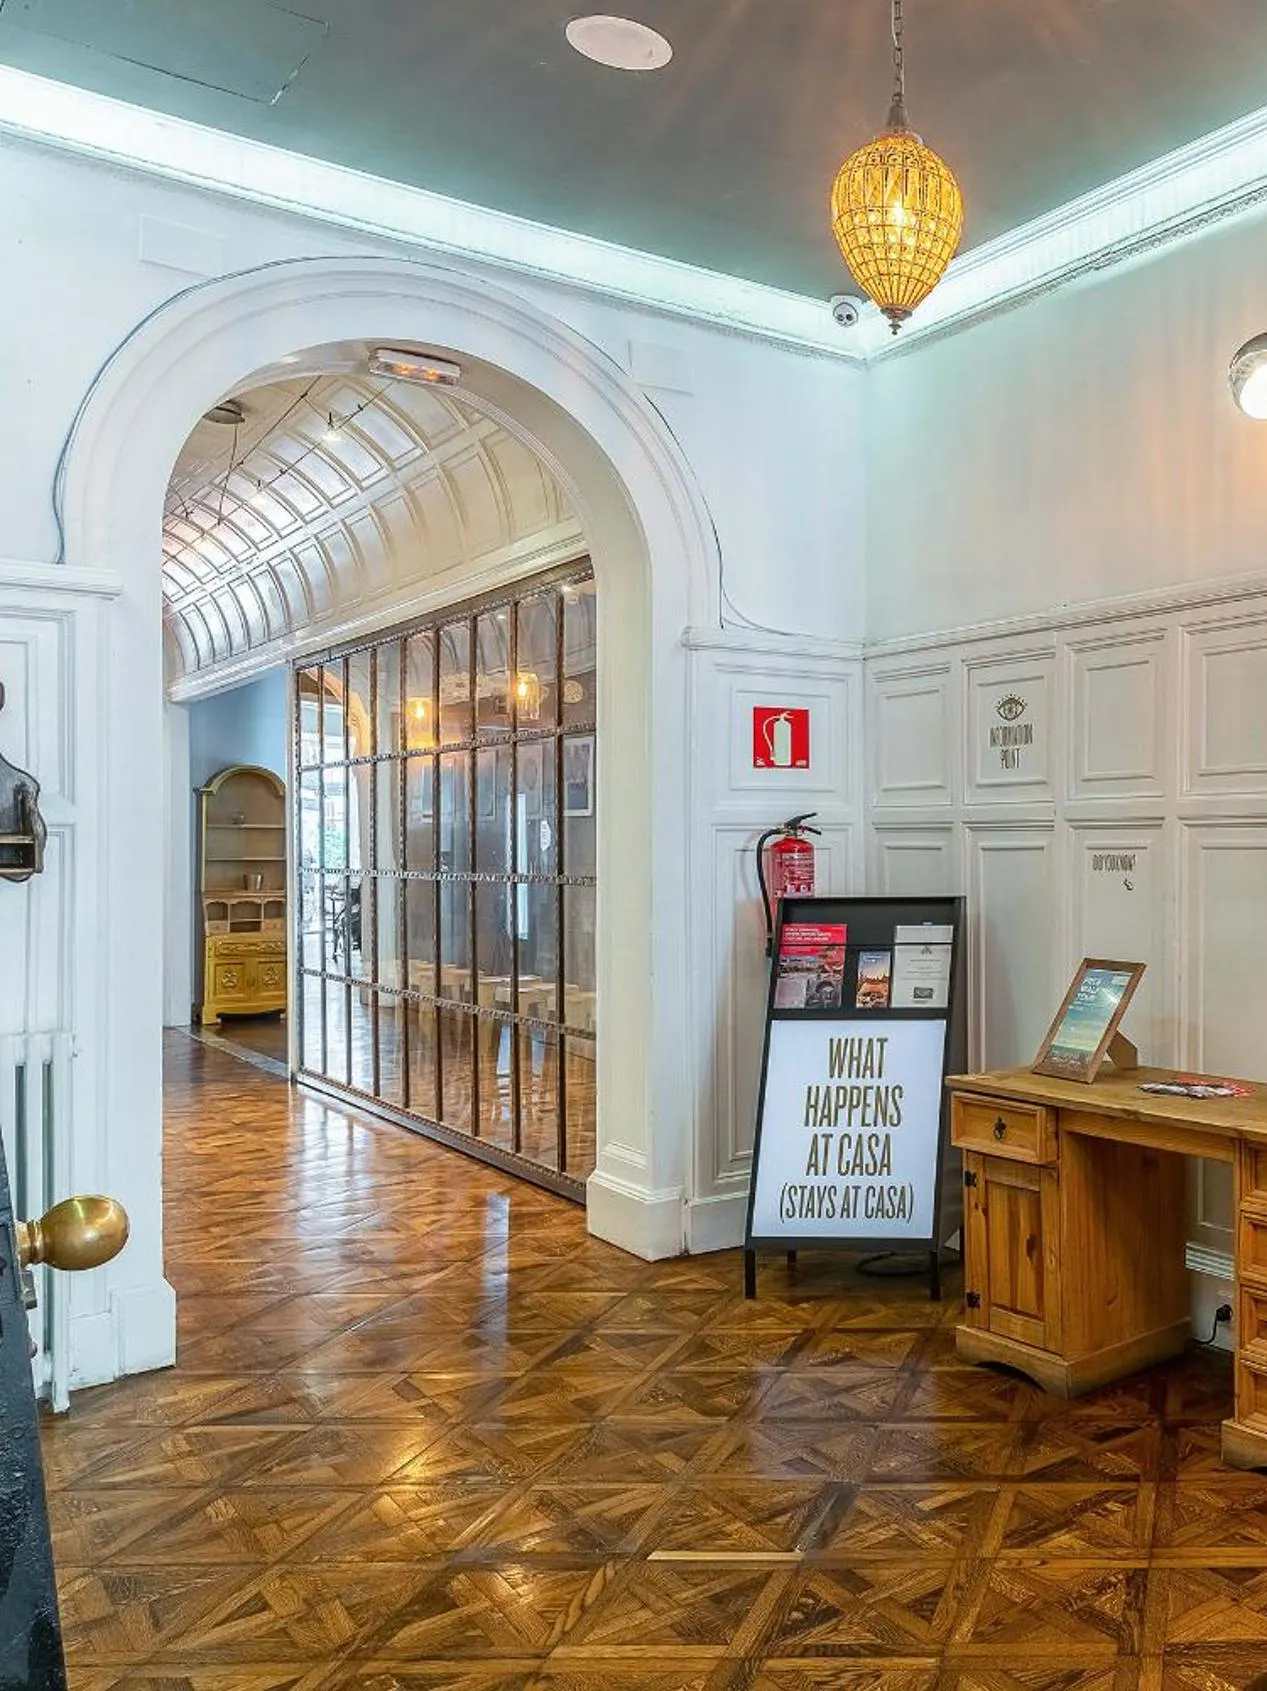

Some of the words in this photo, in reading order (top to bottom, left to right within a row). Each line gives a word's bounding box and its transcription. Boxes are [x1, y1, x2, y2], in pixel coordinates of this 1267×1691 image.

[828, 1037, 889, 1079] WHAT
[804, 1085, 904, 1128] HAPPENS
[805, 1133, 834, 1176] AT
[837, 1133, 892, 1176] CASA
[779, 1182, 837, 1223] (STAYS
[839, 1185, 861, 1219] AT
[864, 1183, 914, 1223] CASA)
